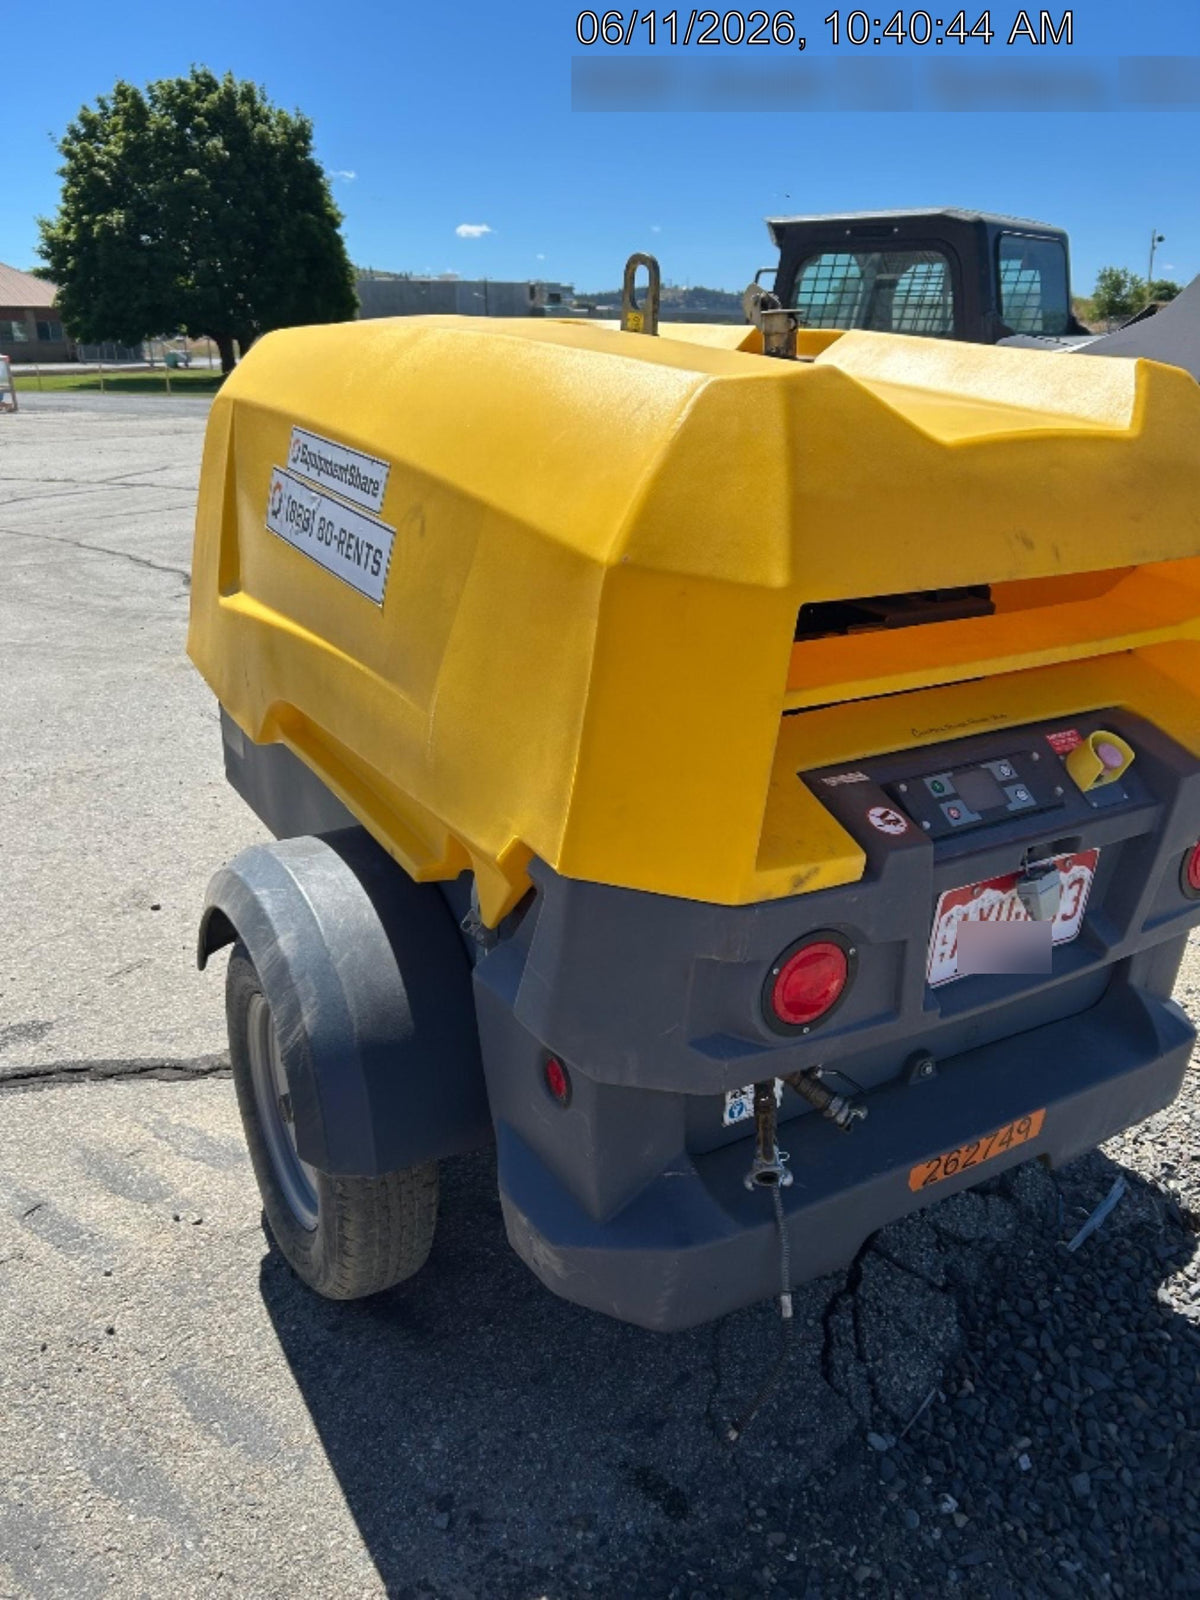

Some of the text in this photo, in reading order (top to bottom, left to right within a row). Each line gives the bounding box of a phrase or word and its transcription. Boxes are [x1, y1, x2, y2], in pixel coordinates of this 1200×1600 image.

[299, 443, 381, 498] EquipmentShare
[317, 516, 383, 577] 80-RENTS
[921, 1116, 1032, 1186] 262749
